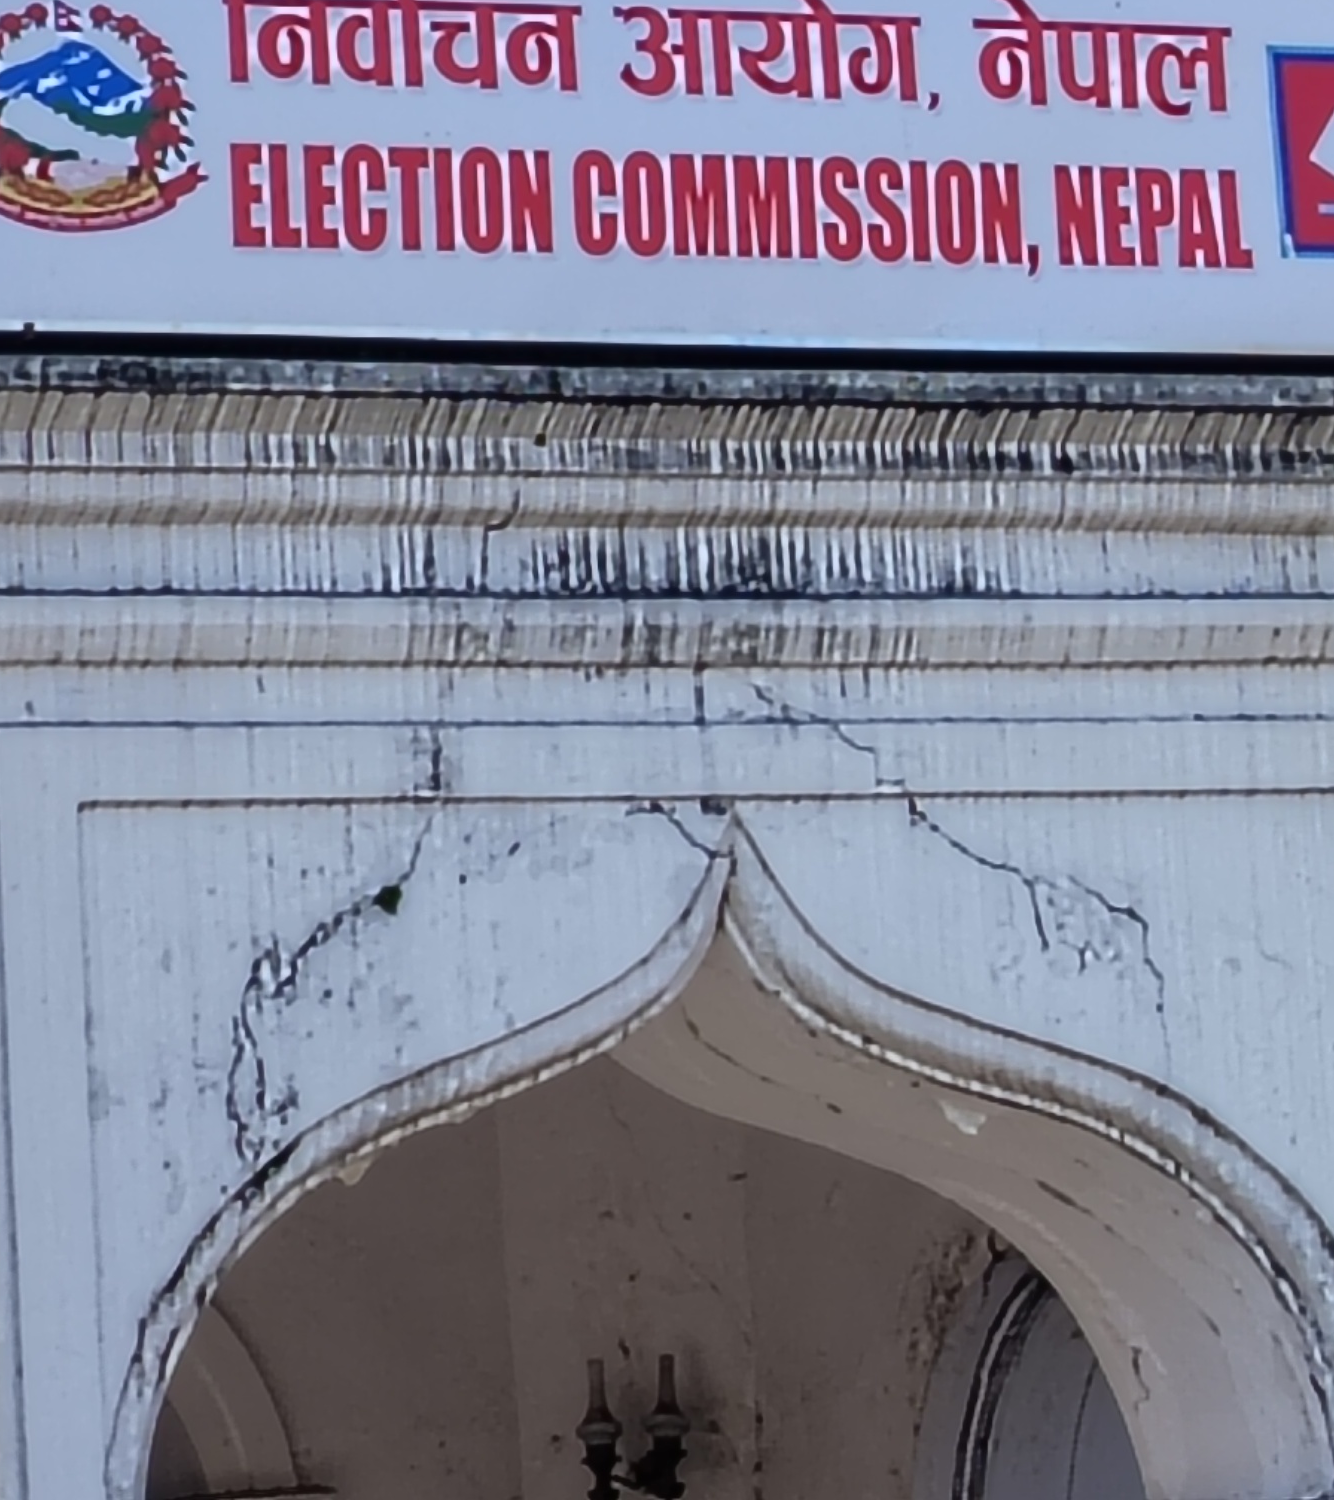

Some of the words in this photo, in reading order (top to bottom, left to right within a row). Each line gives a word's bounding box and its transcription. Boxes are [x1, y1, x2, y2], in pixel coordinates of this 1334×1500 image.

[229, 143, 554, 253] ELECTION
[572, 149, 1040, 276] COMMISSION,
[1053, 164, 1254, 268] NEPAL
